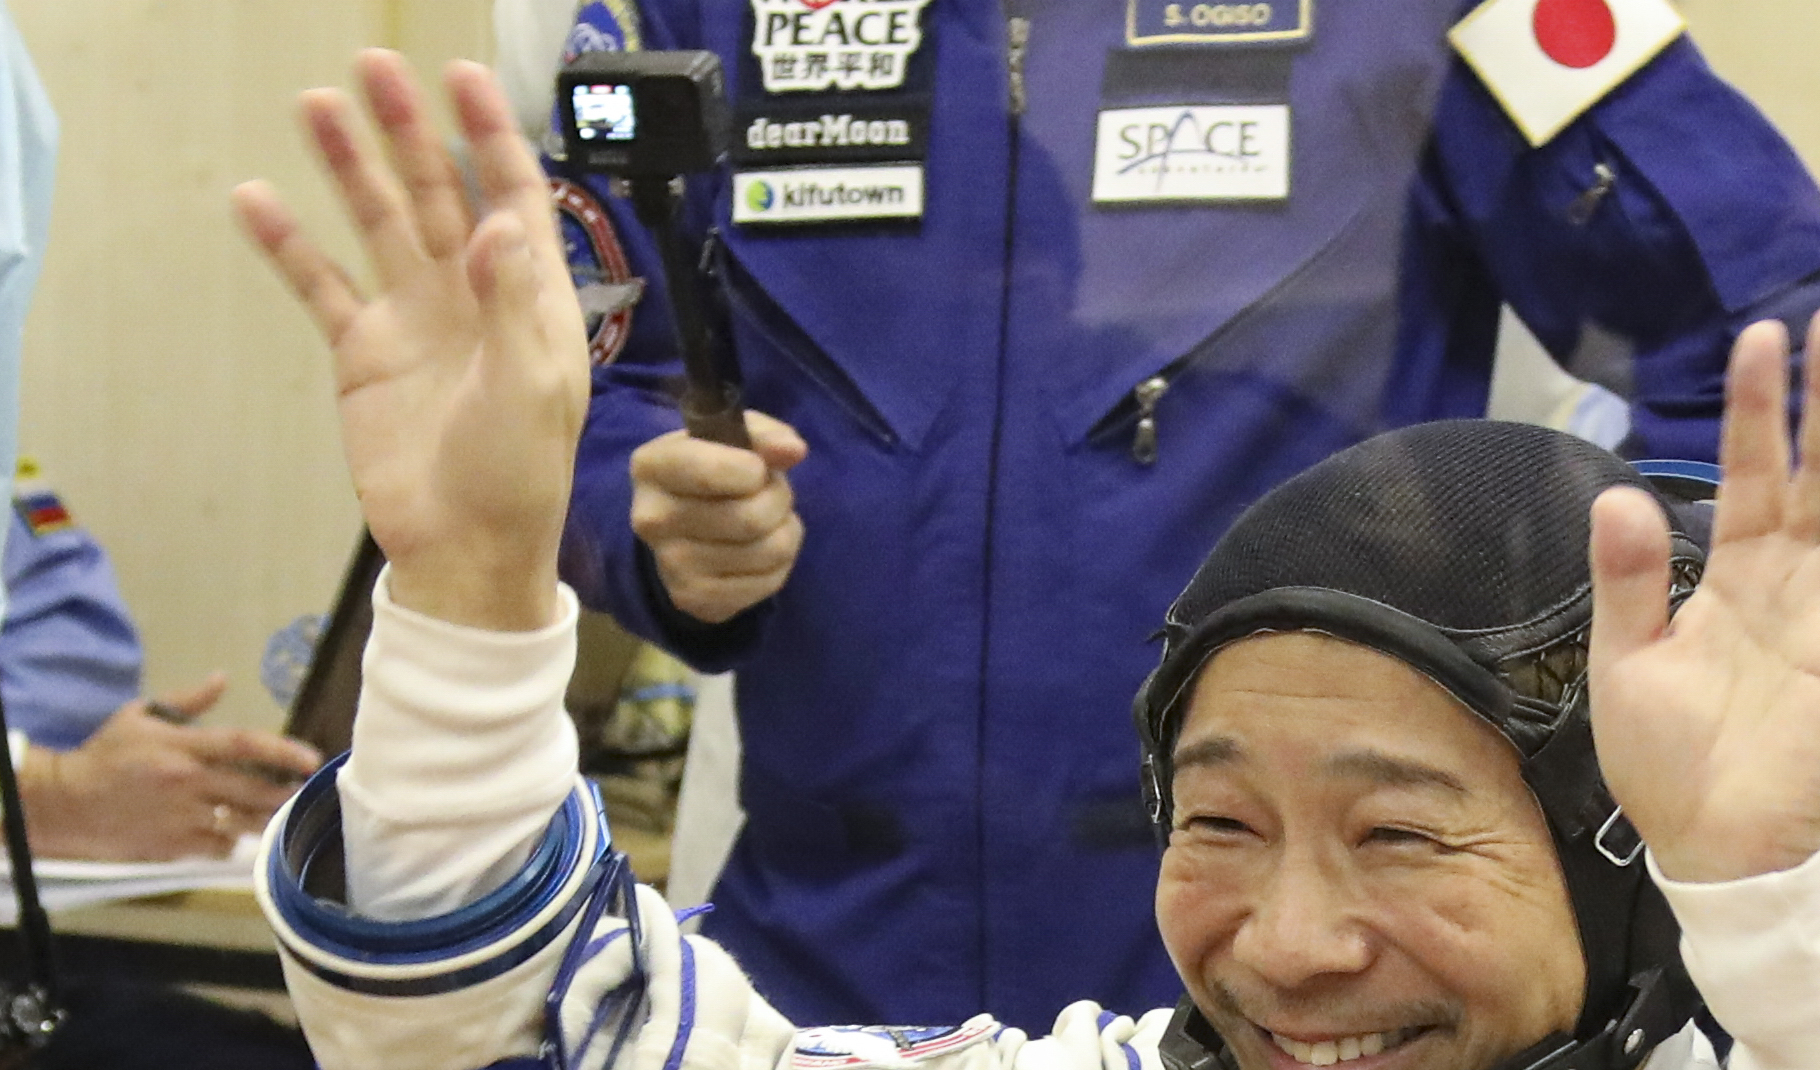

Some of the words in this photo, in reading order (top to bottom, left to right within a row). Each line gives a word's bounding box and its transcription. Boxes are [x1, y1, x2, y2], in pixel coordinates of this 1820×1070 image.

[764, 11, 908, 46] PEACE
[772, 52, 894, 79] 世界平和
[747, 114, 910, 149] dearMoon
[1117, 110, 1261, 160] SPACE
[783, 182, 904, 208] kifutown
